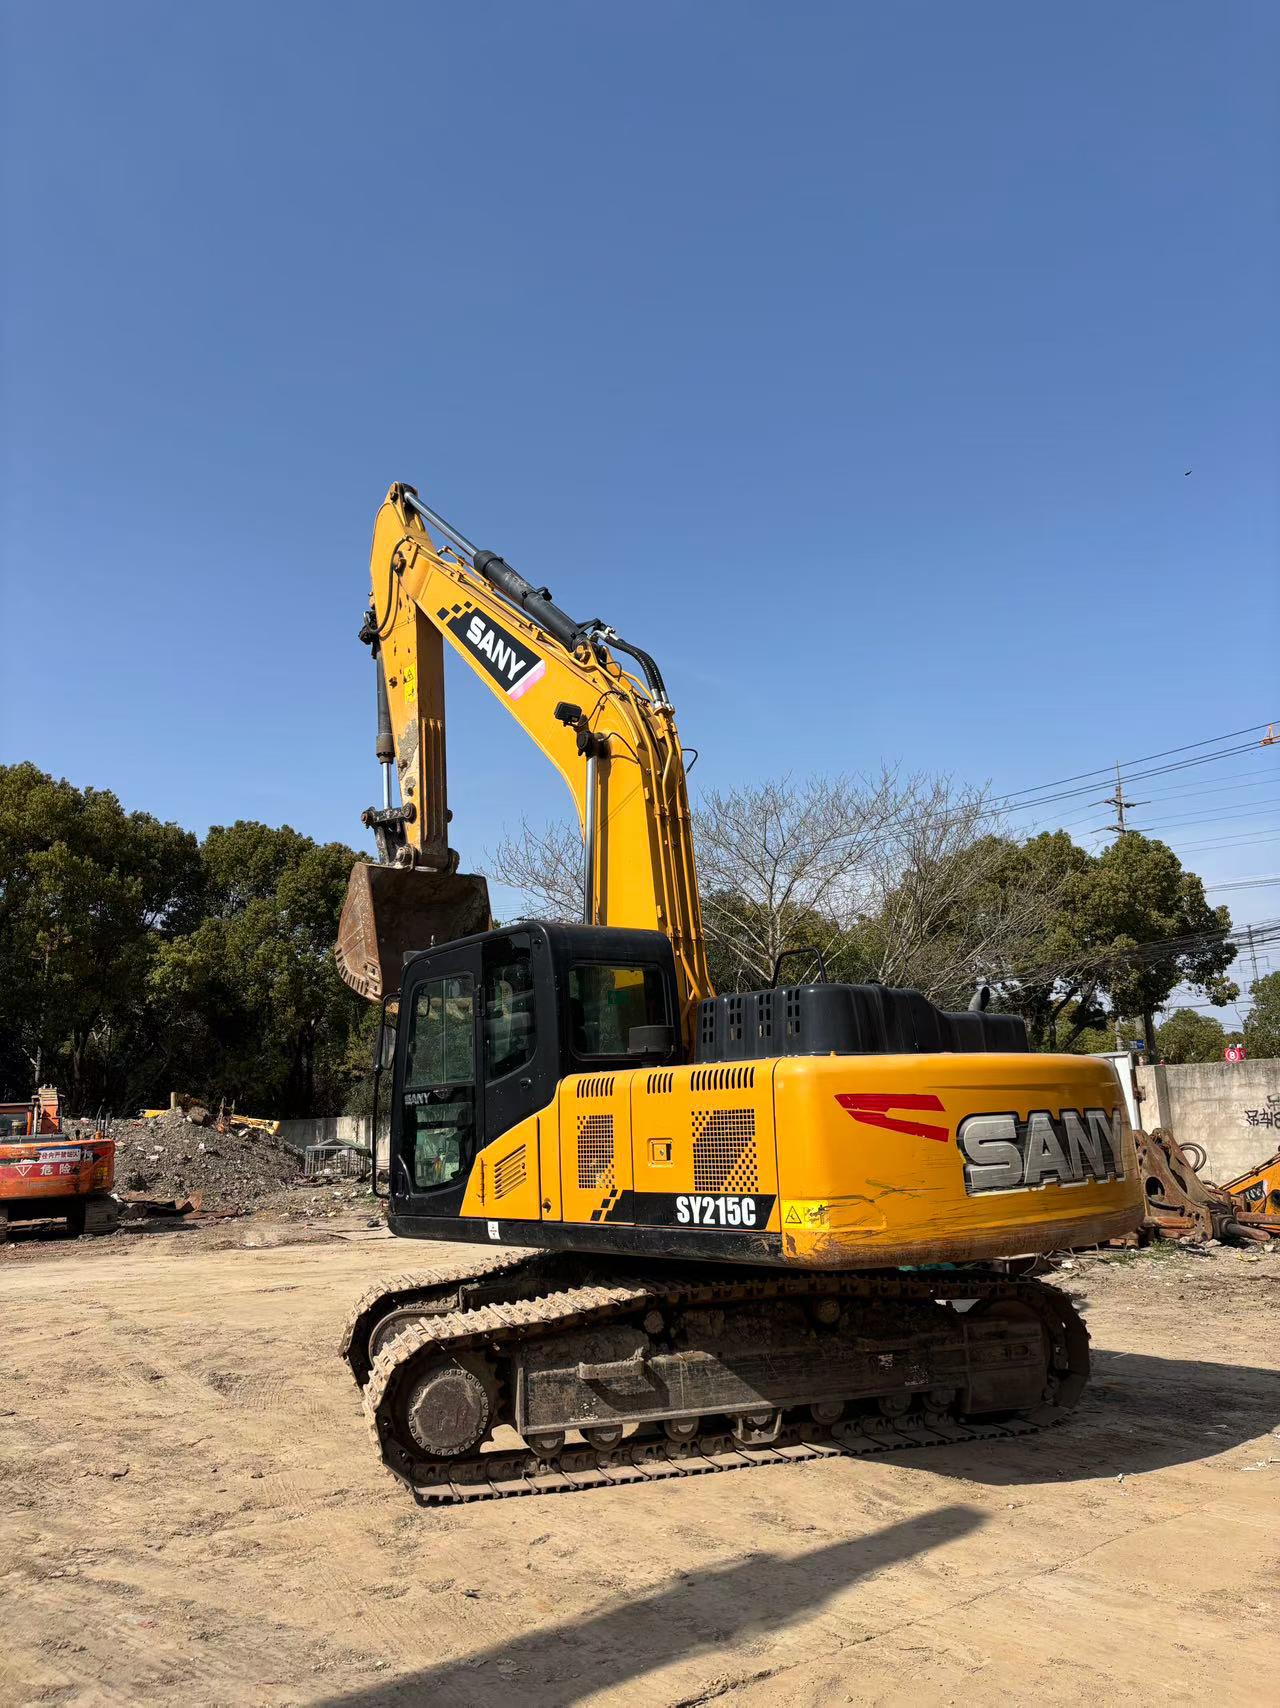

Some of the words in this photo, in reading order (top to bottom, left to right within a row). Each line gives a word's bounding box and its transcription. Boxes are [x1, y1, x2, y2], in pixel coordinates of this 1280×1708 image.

[466, 615, 527, 681] SANY
[404, 1092, 431, 1105] SANY
[957, 1108, 1126, 1197] SANY
[676, 1195, 756, 1227] SY215C
